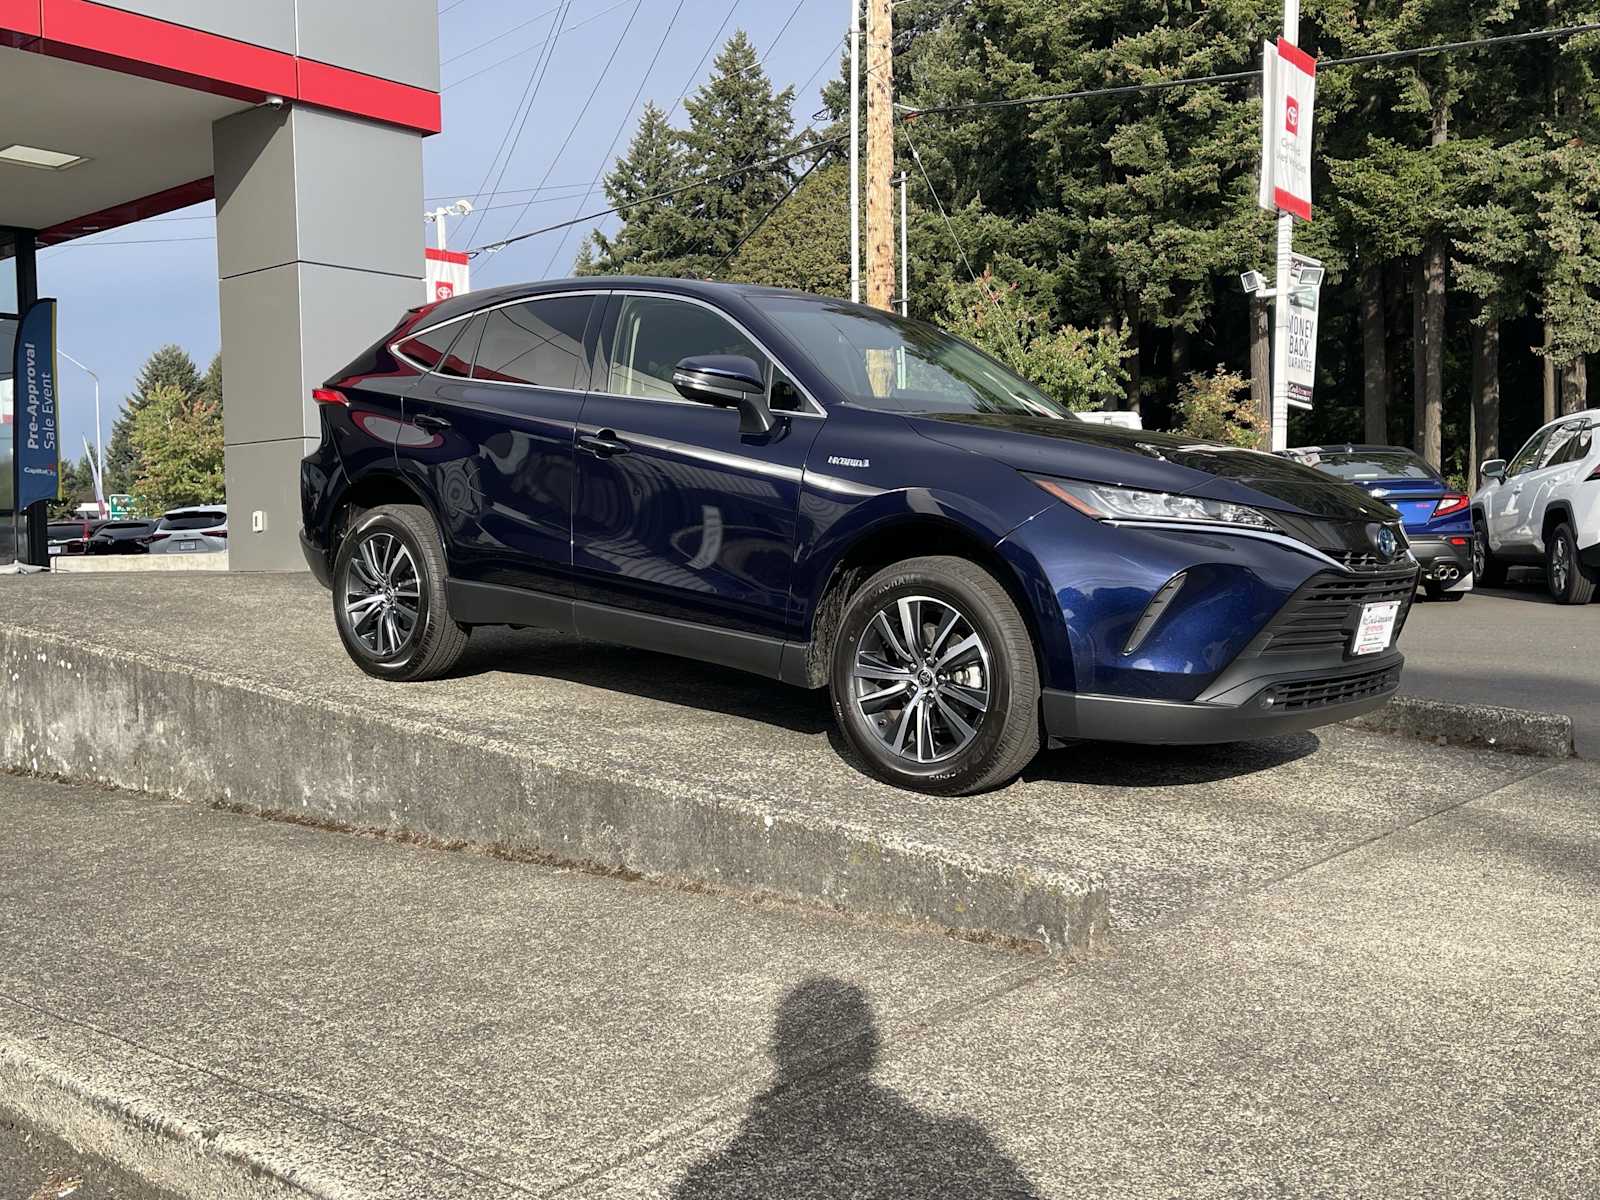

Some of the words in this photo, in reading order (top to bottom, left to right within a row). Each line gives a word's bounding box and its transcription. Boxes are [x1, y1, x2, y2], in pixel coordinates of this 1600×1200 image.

[1289, 335, 1309, 358] BACK
[1288, 356, 1313, 373] UARANTEE
[25, 343, 40, 449] Pre-Approval
[41, 372, 54, 413] Event
[42, 418, 56, 449] Sale
